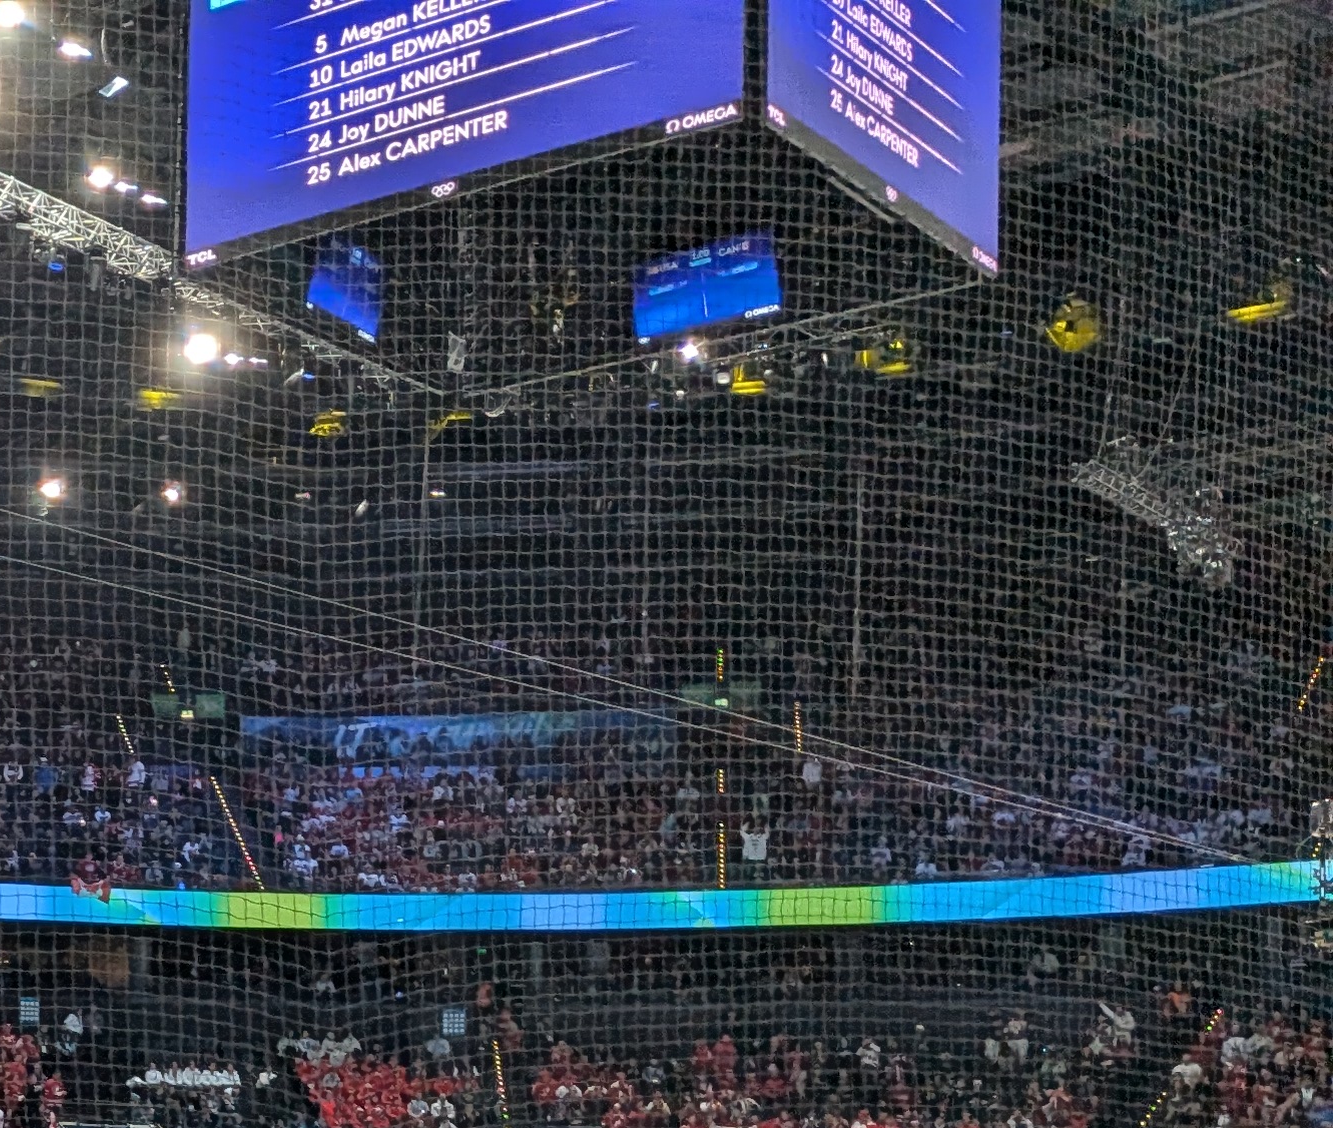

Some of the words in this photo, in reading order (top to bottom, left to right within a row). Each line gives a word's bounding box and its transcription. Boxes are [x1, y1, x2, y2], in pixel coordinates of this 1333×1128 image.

[309, 66, 332, 88] 10
[339, 51, 386, 79] Laila
[391, 15, 491, 62] EDWARDS
[315, 34, 328, 54] 5
[340, 13, 408, 46] Megan
[412, 0, 479, 22] KELL
[831, 19, 844, 44] 21
[874, 50, 909, 91] KNIGHT
[308, 97, 332, 120] 21
[339, 81, 396, 112] Hilary
[400, 51, 481, 91] KNIGHT
[830, 55, 843, 78] 24
[862, 77, 894, 116] DUNNE
[307, 130, 331, 153] 24
[338, 121, 371, 146] Joy
[374, 96, 445, 133] DUNNE
[681, 103, 738, 130] OMEGA
[767, 104, 787, 127] TCL
[867, 116, 921, 169] CARPENTER
[307, 163, 331, 186] 25
[338, 150, 381, 177] Alex
[385, 110, 509, 161] CARPENTER
[186, 249, 217, 266] TCL
